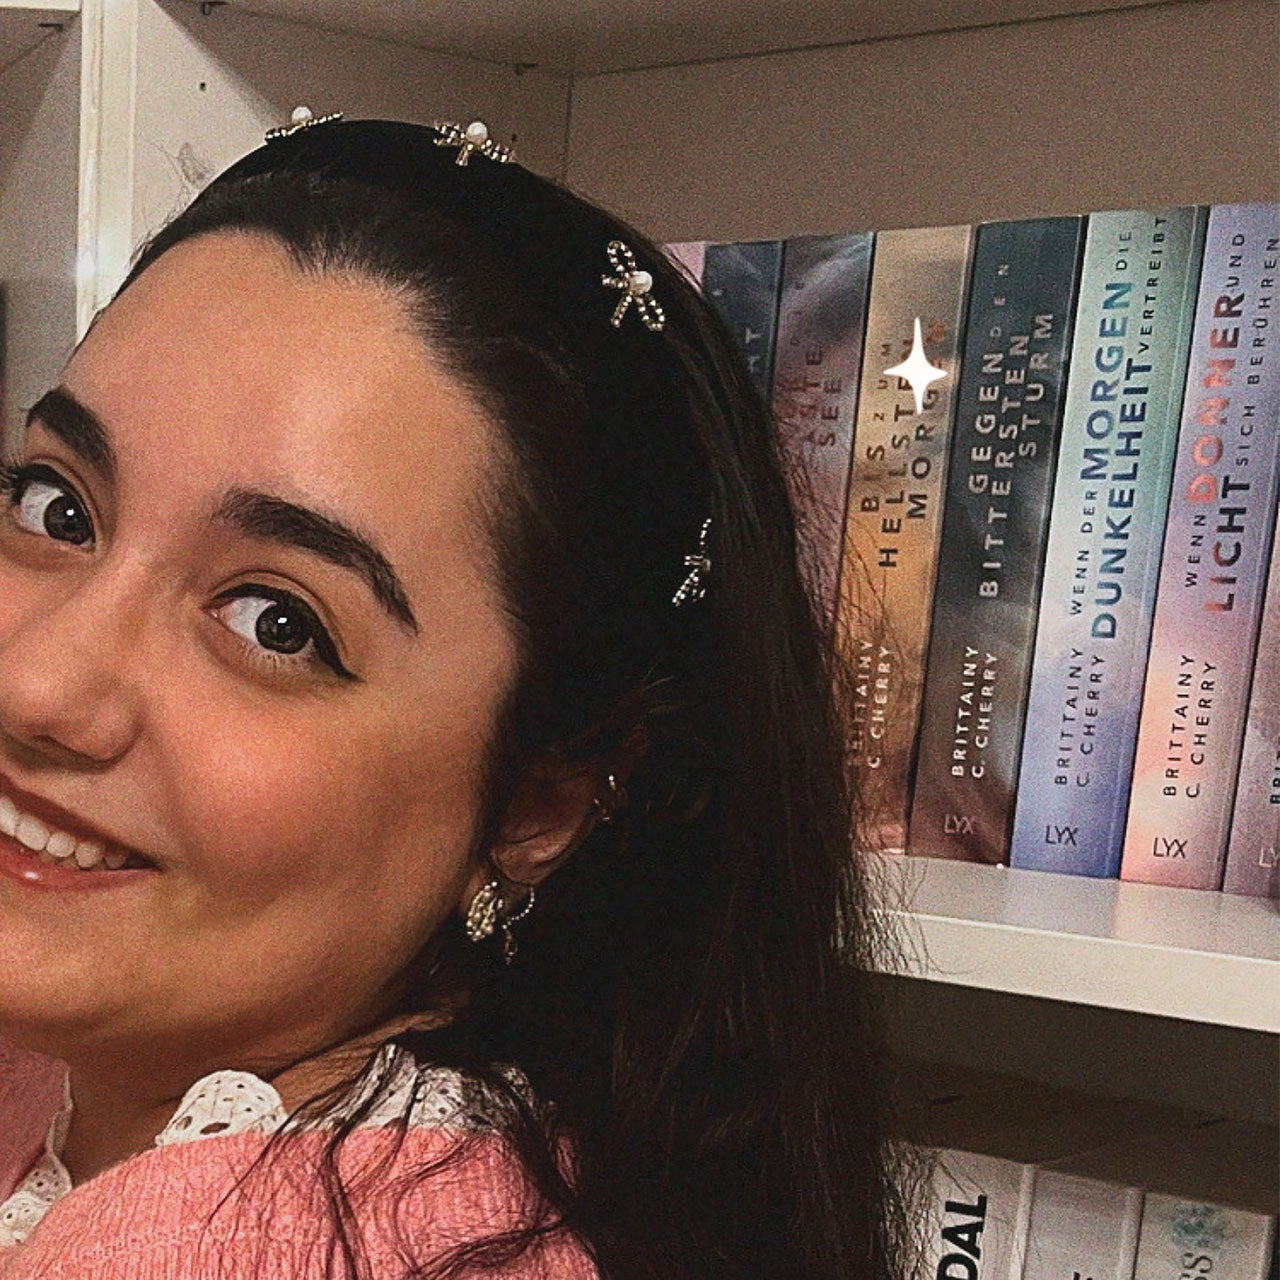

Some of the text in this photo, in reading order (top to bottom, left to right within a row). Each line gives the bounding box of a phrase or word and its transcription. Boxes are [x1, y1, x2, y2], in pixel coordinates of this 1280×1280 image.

[860, 343, 892, 513] BIS ZUM
[906, 318, 947, 519] MORGN
[968, 263, 1010, 496] GEGEN DEN
[1018, 312, 1055, 458] STURM
[1068, 230, 1134, 617] WENN DER MORGEN DIE
[1090, 217, 1167, 640] DUNKELHEIT VERTREIBT
[1184, 232, 1247, 588] WENN DONNER UND
[1202, 236, 1280, 613] LICHT SICH BERÜHREN
[979, 334, 1031, 598] BITTERSTEN
[870, 646, 894, 741] CHERRY
[951, 645, 980, 777] BRITTAINY
[974, 652, 999, 749] CHERRY
[1054, 647, 1084, 786] BRITTAINY
[1079, 654, 1106, 756] CHERRY
[1162, 654, 1196, 797] BRITTAINY
[1189, 662, 1218, 766] CHERRY
[943, 813, 975, 835] LYX
[1044, 824, 1079, 846] LYX
[1152, 837, 1189, 859] LYX
[1259, 846, 1280, 868] LY
